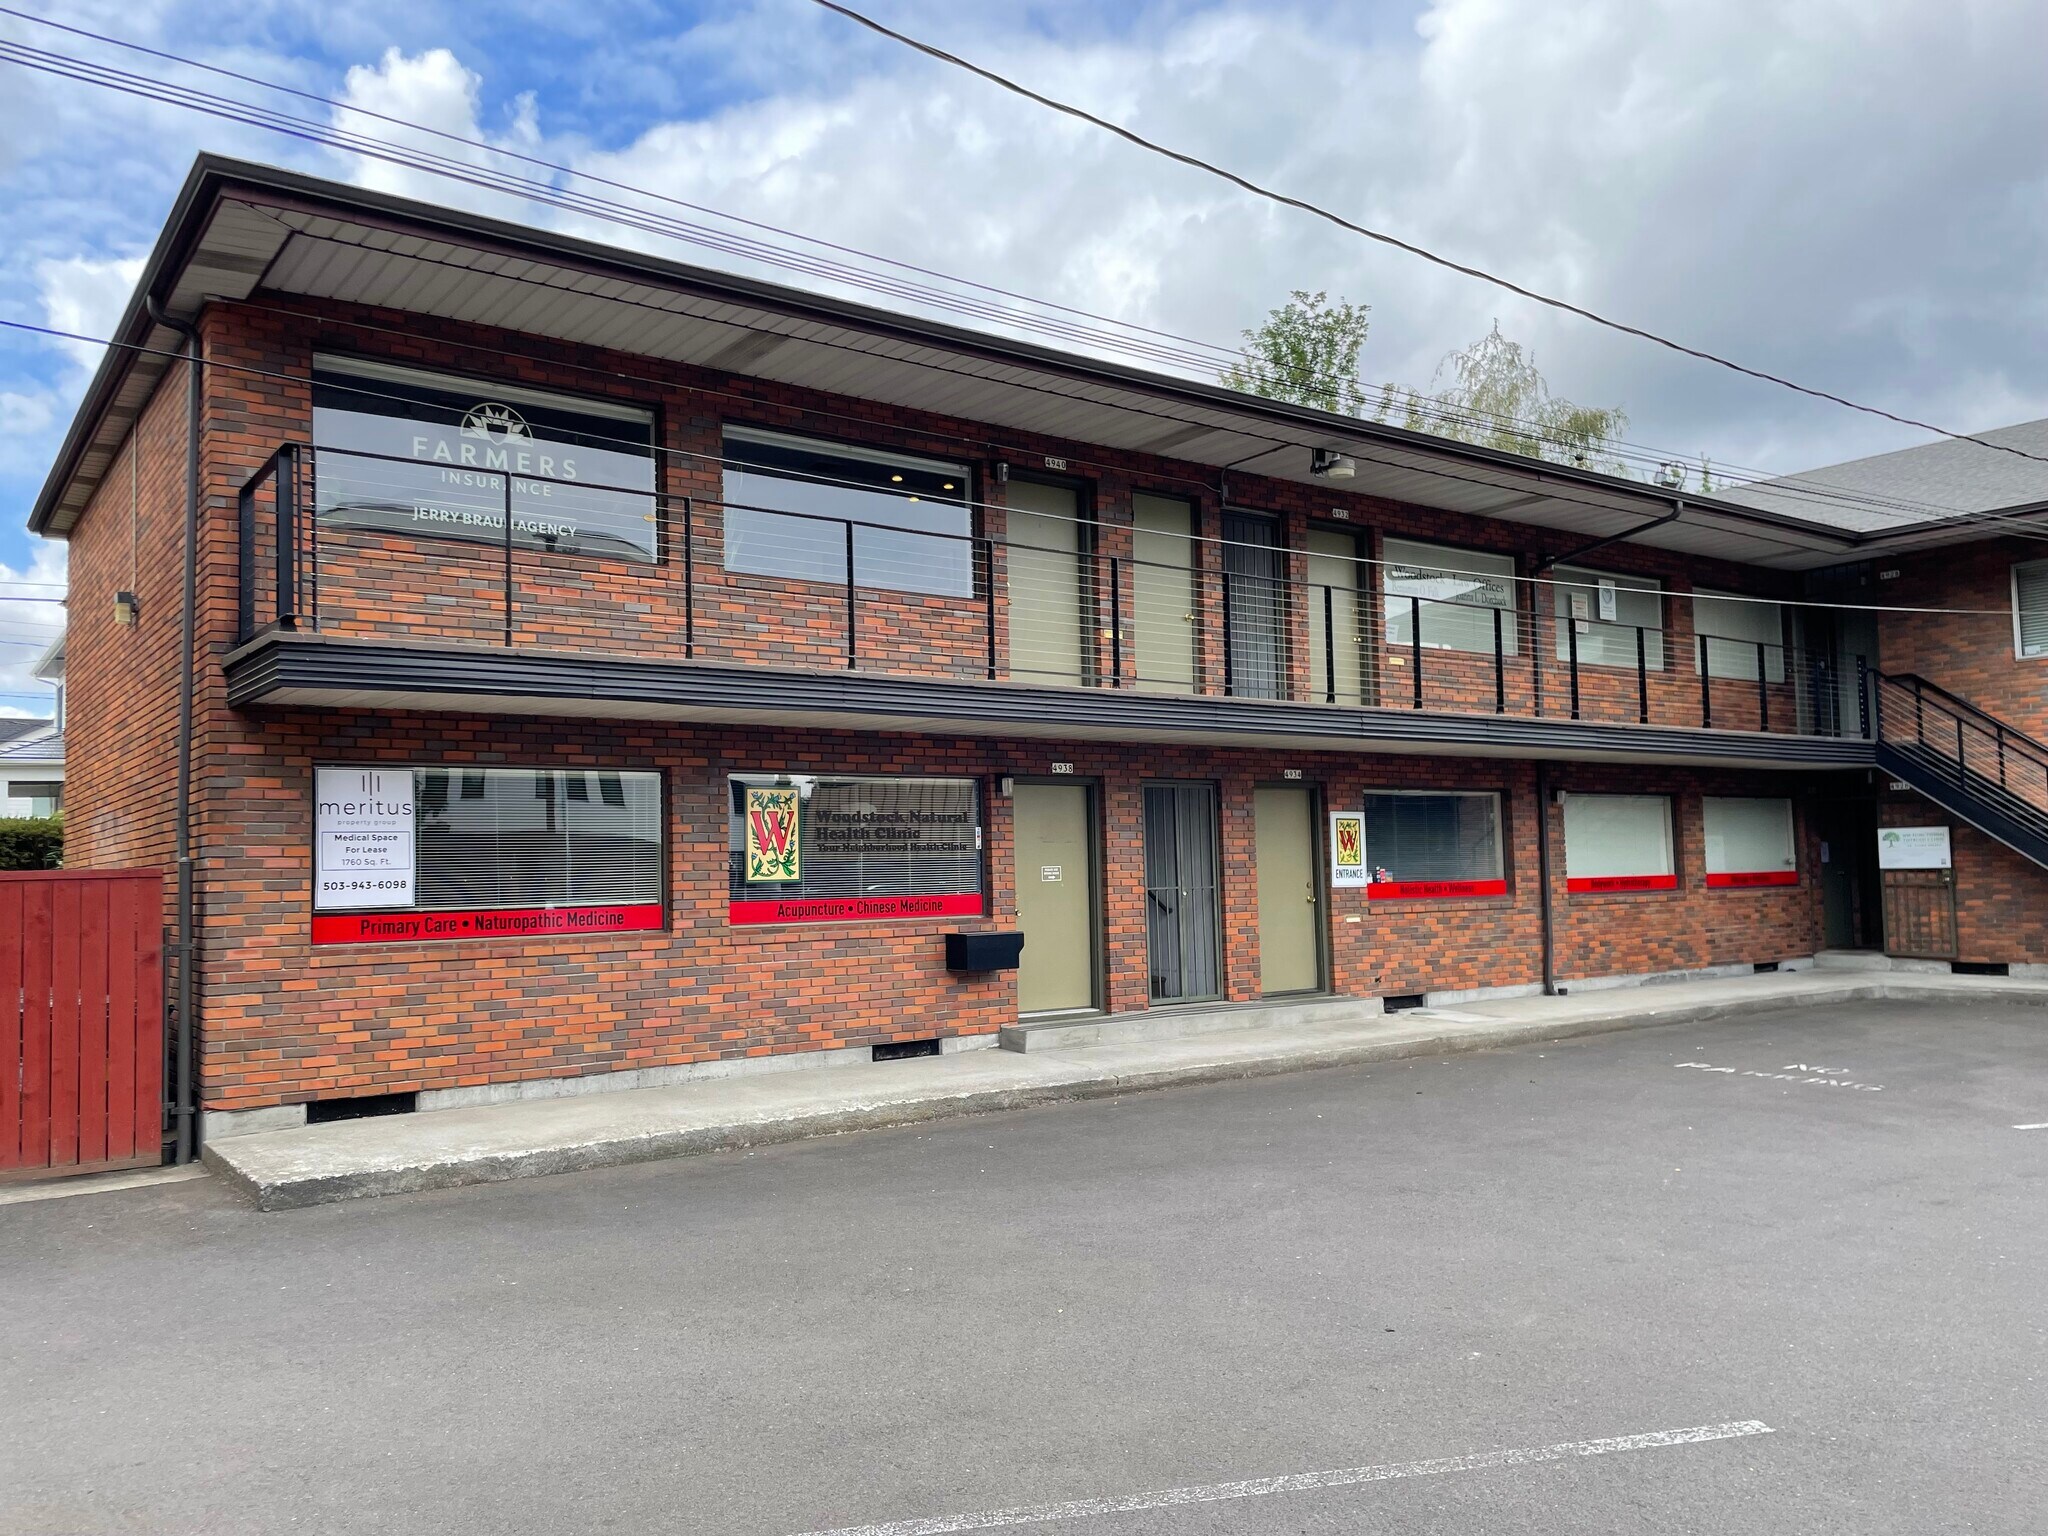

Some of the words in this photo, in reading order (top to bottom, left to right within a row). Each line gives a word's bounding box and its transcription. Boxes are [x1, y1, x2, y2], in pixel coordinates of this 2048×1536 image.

[413, 436, 577, 480] FARMERS
[1046, 458, 1066, 469] 4940
[441, 471, 552, 497] INSURNCE
[412, 506, 460, 523] JERRY
[517, 521, 577, 537] AGENCY
[1052, 763, 1073, 773] 4938
[319, 798, 412, 816] meritus
[816, 810, 906, 823] Woodstock
[909, 809, 968, 823] Natural
[371, 834, 398, 843] Space
[750, 811, 794, 855] W
[815, 827, 870, 840] Health
[875, 826, 921, 839] Clinic
[1339, 830, 1358, 852] W
[1335, 869, 1363, 879] ENTRANCE
[323, 880, 407, 890] 503-943-6098
[777, 903, 845, 918] Acupuncture
[857, 901, 896, 914] Chinese
[900, 899, 943, 912] Medicine
[360, 917, 421, 937] Primary
[424, 914, 457, 933] Care
[475, 912, 563, 932] Naturopathic
[567, 910, 624, 928] Medicine
